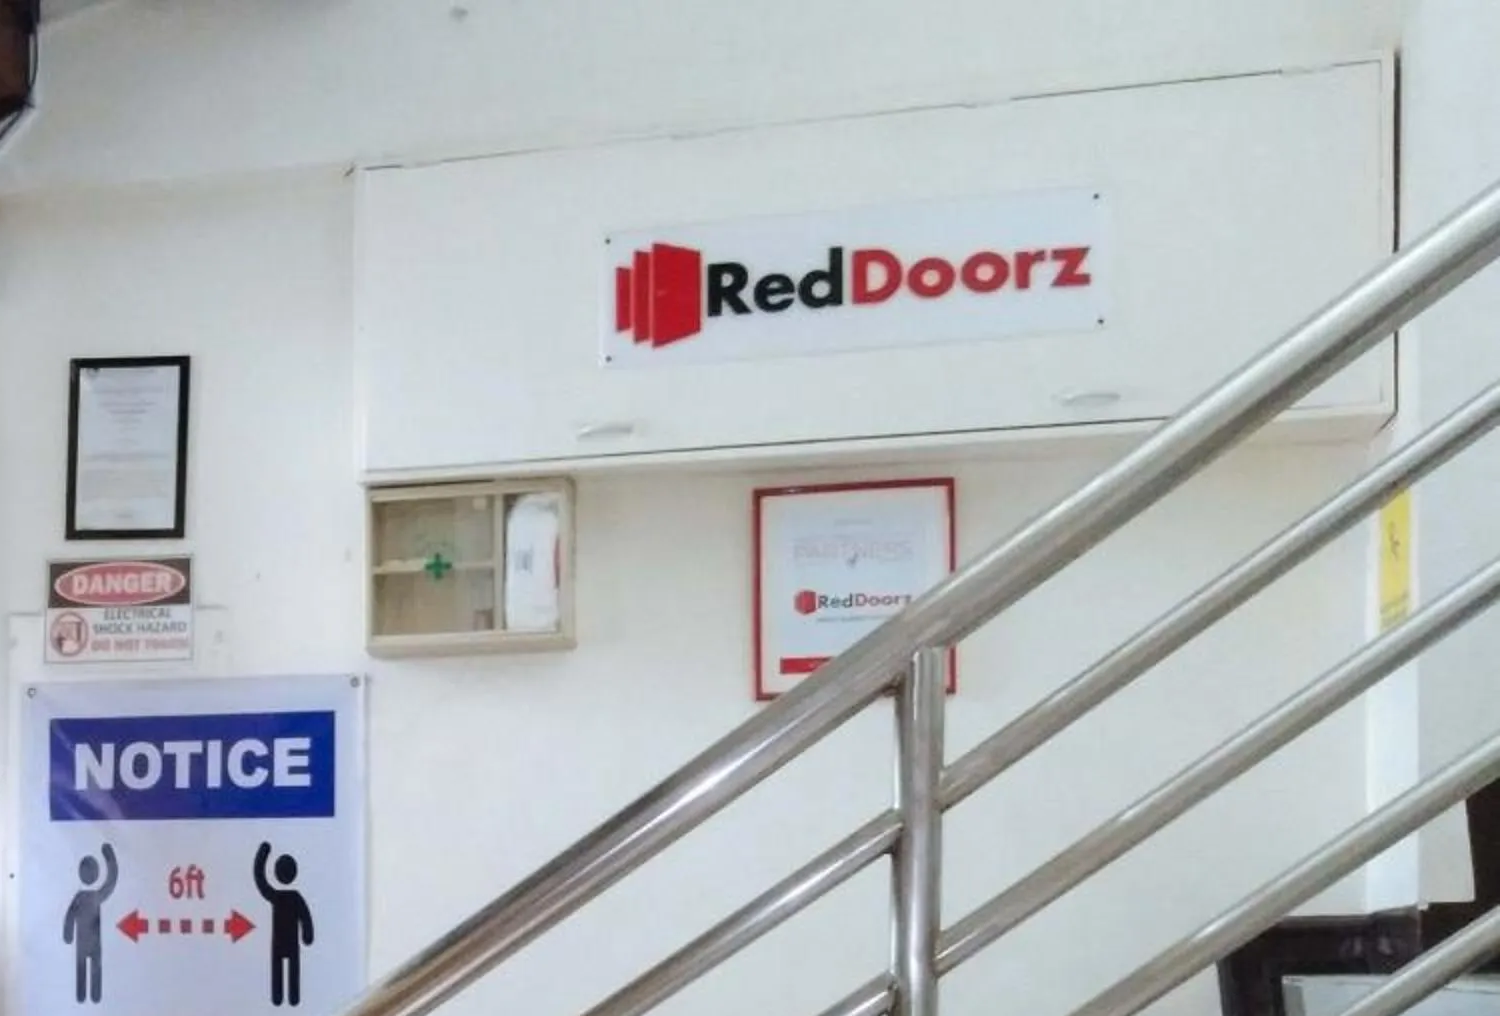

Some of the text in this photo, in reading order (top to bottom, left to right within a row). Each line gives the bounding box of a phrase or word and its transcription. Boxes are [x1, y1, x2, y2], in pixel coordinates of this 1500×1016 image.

[706, 246, 1092, 318] RedDoorz
[71, 571, 172, 597] DANGER
[103, 608, 171, 621] ELECTRICAL
[137, 620, 188, 634] HAZARD
[74, 738, 312, 791] NOTICE
[168, 865, 206, 900] 6ft
